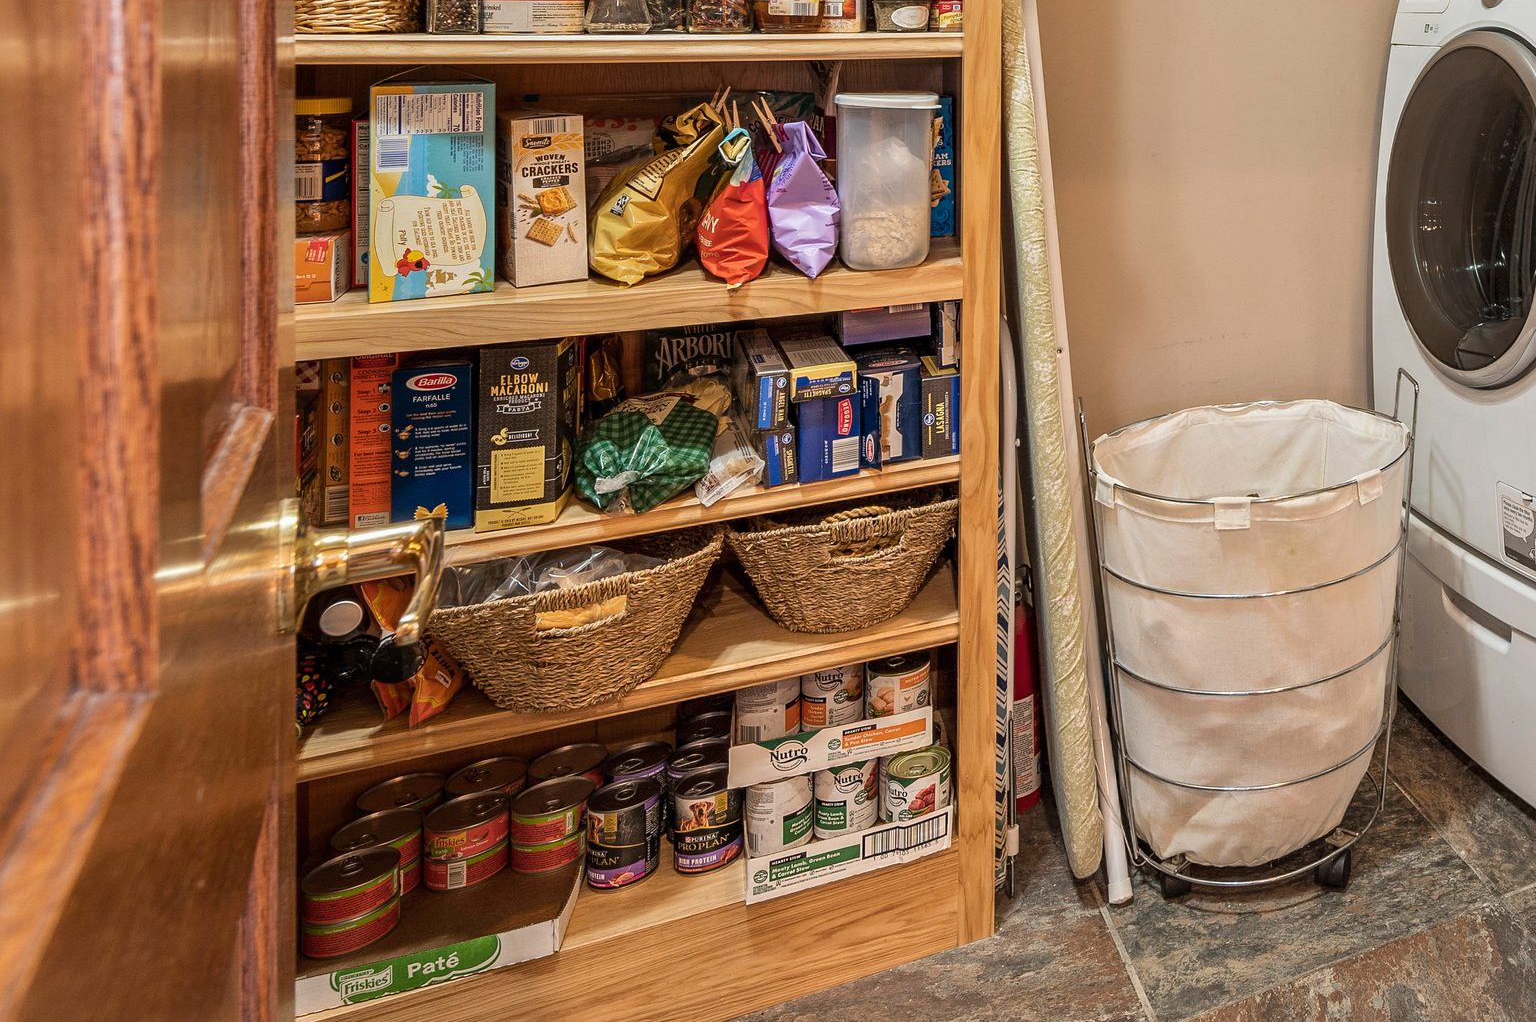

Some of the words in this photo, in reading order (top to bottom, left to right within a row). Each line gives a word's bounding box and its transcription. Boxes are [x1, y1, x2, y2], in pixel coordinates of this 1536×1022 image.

[453, 124, 460, 132] 70
[535, 154, 566, 163] WOVEN
[522, 163, 578, 178] CRACKERS
[398, 230, 407, 245] Polly
[656, 333, 732, 380] ARBORI
[418, 376, 452, 387] Barilla
[500, 373, 539, 386] ELBOW
[490, 382, 549, 397] MACARONI
[804, 388, 832, 398] SPAGHETTI
[413, 393, 451, 403] FARFALLE
[840, 401, 849, 433] REGGANO
[936, 401, 945, 434] LASAGNA
[431, 649, 456, 679] WHITE
[814, 672, 844, 682] Nutro
[863, 730, 883, 738] Chicken,
[770, 747, 809, 763] Nutro
[834, 772, 864, 785] Nutro
[435, 837, 466, 848] Friskies
[678, 843, 696, 851] PRO
[698, 836, 728, 850] PLAN
[691, 833, 716, 843] PURINA
[691, 855, 717, 864] PROTEIN
[772, 866, 790, 874] Meaty
[791, 862, 808, 870] Lamb,
[778, 869, 795, 877] Carrot
[408, 952, 460, 979] Paté
[344, 976, 388, 994] Friskies
